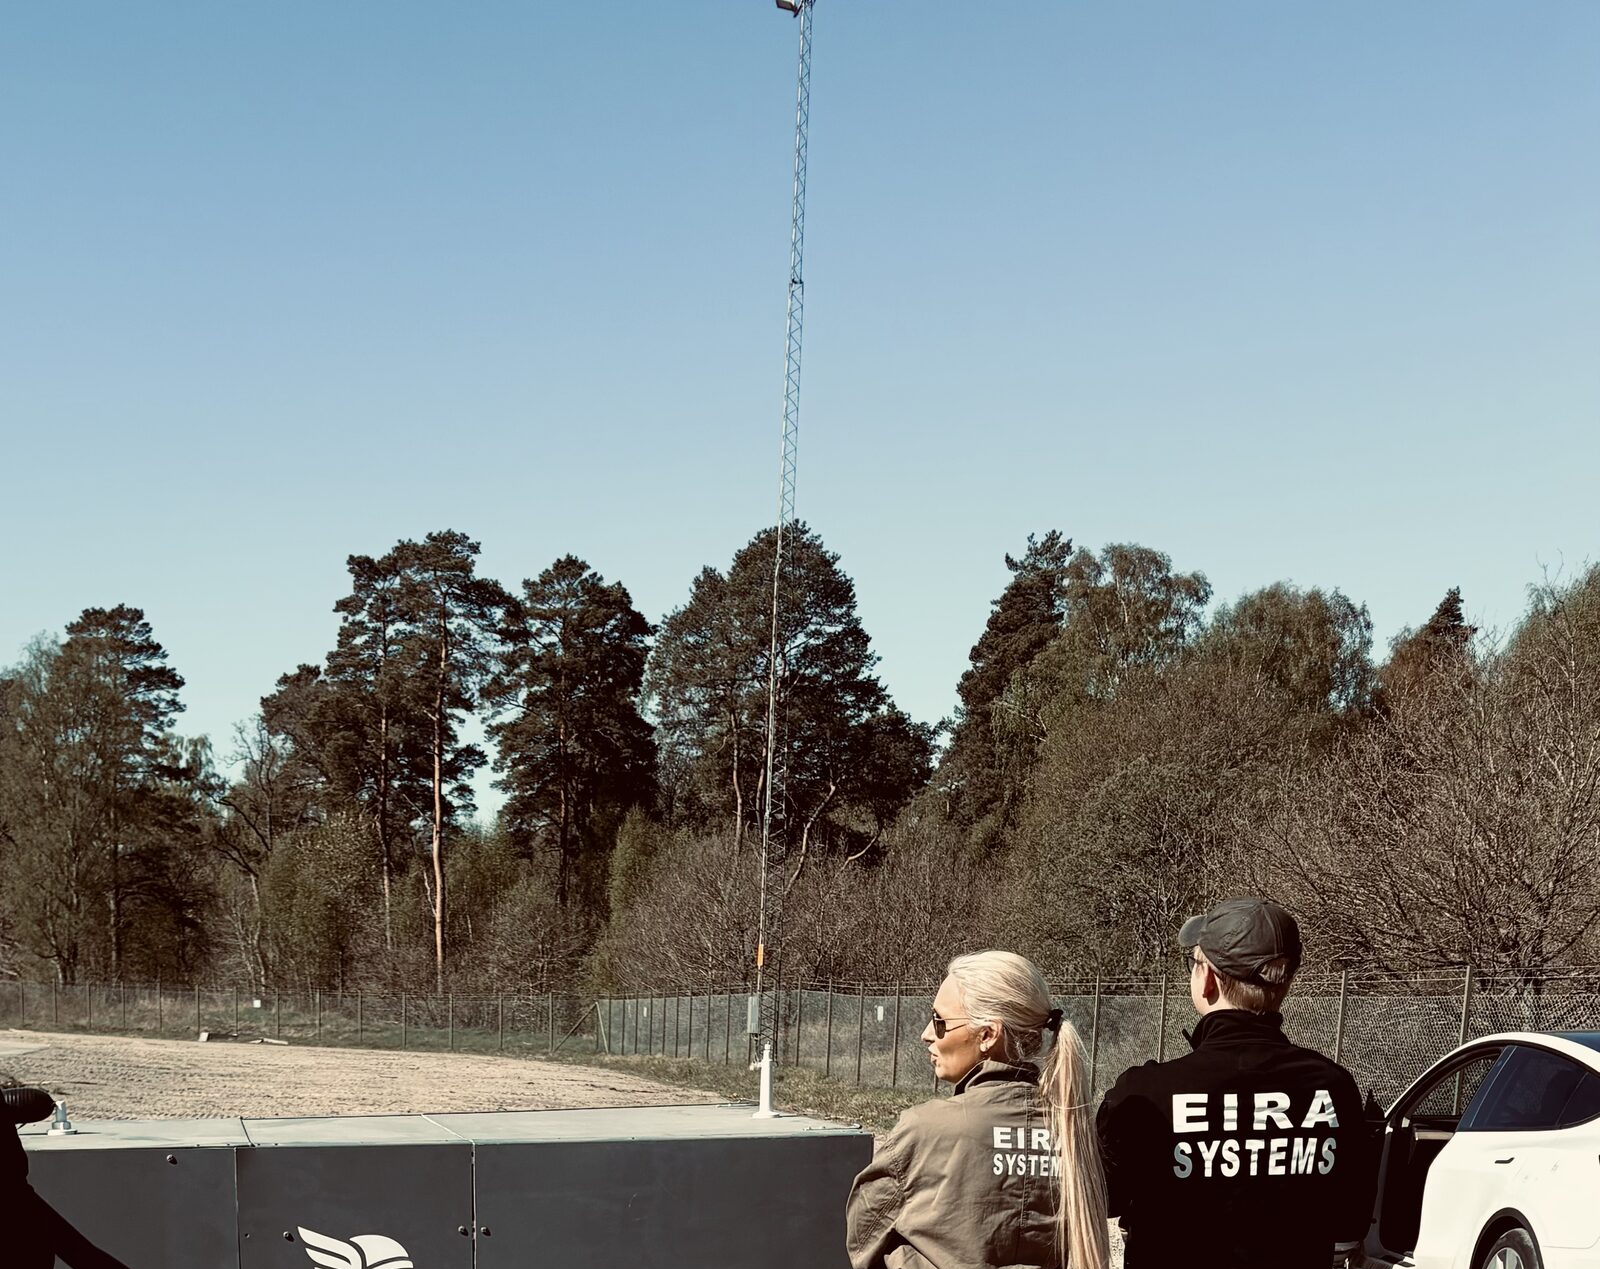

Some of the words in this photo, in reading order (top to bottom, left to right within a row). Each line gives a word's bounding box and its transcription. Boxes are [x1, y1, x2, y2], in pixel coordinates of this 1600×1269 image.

[1172, 1090, 1340, 1133] EIRA
[993, 1153, 1062, 1177] SYSTEM
[1173, 1137, 1337, 1179] SYSTEMS
